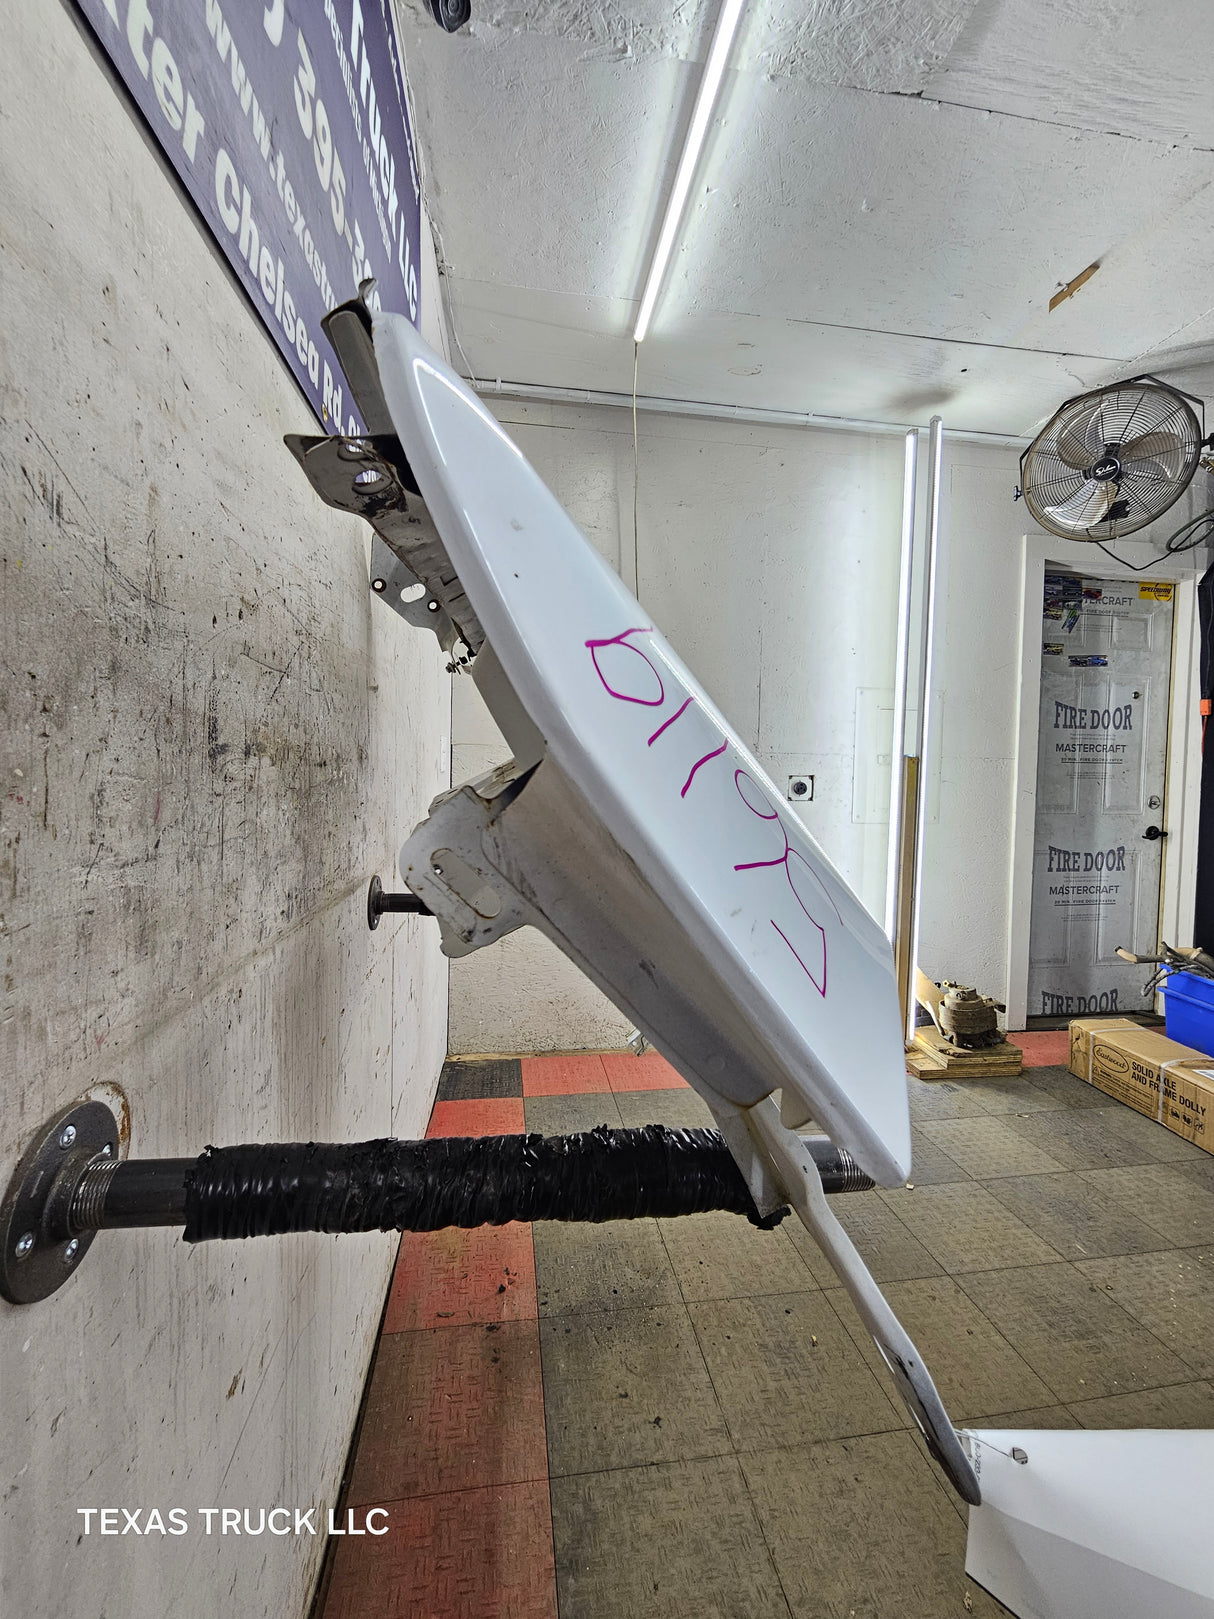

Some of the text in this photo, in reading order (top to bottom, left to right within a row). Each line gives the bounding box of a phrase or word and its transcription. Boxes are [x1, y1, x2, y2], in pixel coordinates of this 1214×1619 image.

[351, 0, 396, 243] Truck
[399, 210, 417, 322] LLC
[215, 147, 319, 391] Chelsea
[1053, 700, 1133, 731] FIRE DOOR
[1055, 743, 1127, 754] MASTERCRAFT
[1047, 845, 1126, 873] FIRE DOOR
[1049, 884, 1120, 896] MASTERCRAFT
[1041, 988, 1119, 1016] FIRE DOOR
[1095, 1047, 1127, 1069] Eastwood
[1131, 1061, 1154, 1079] SOLID
[1131, 1071, 1147, 1086] AND
[1179, 1095, 1206, 1117] DOLLY
